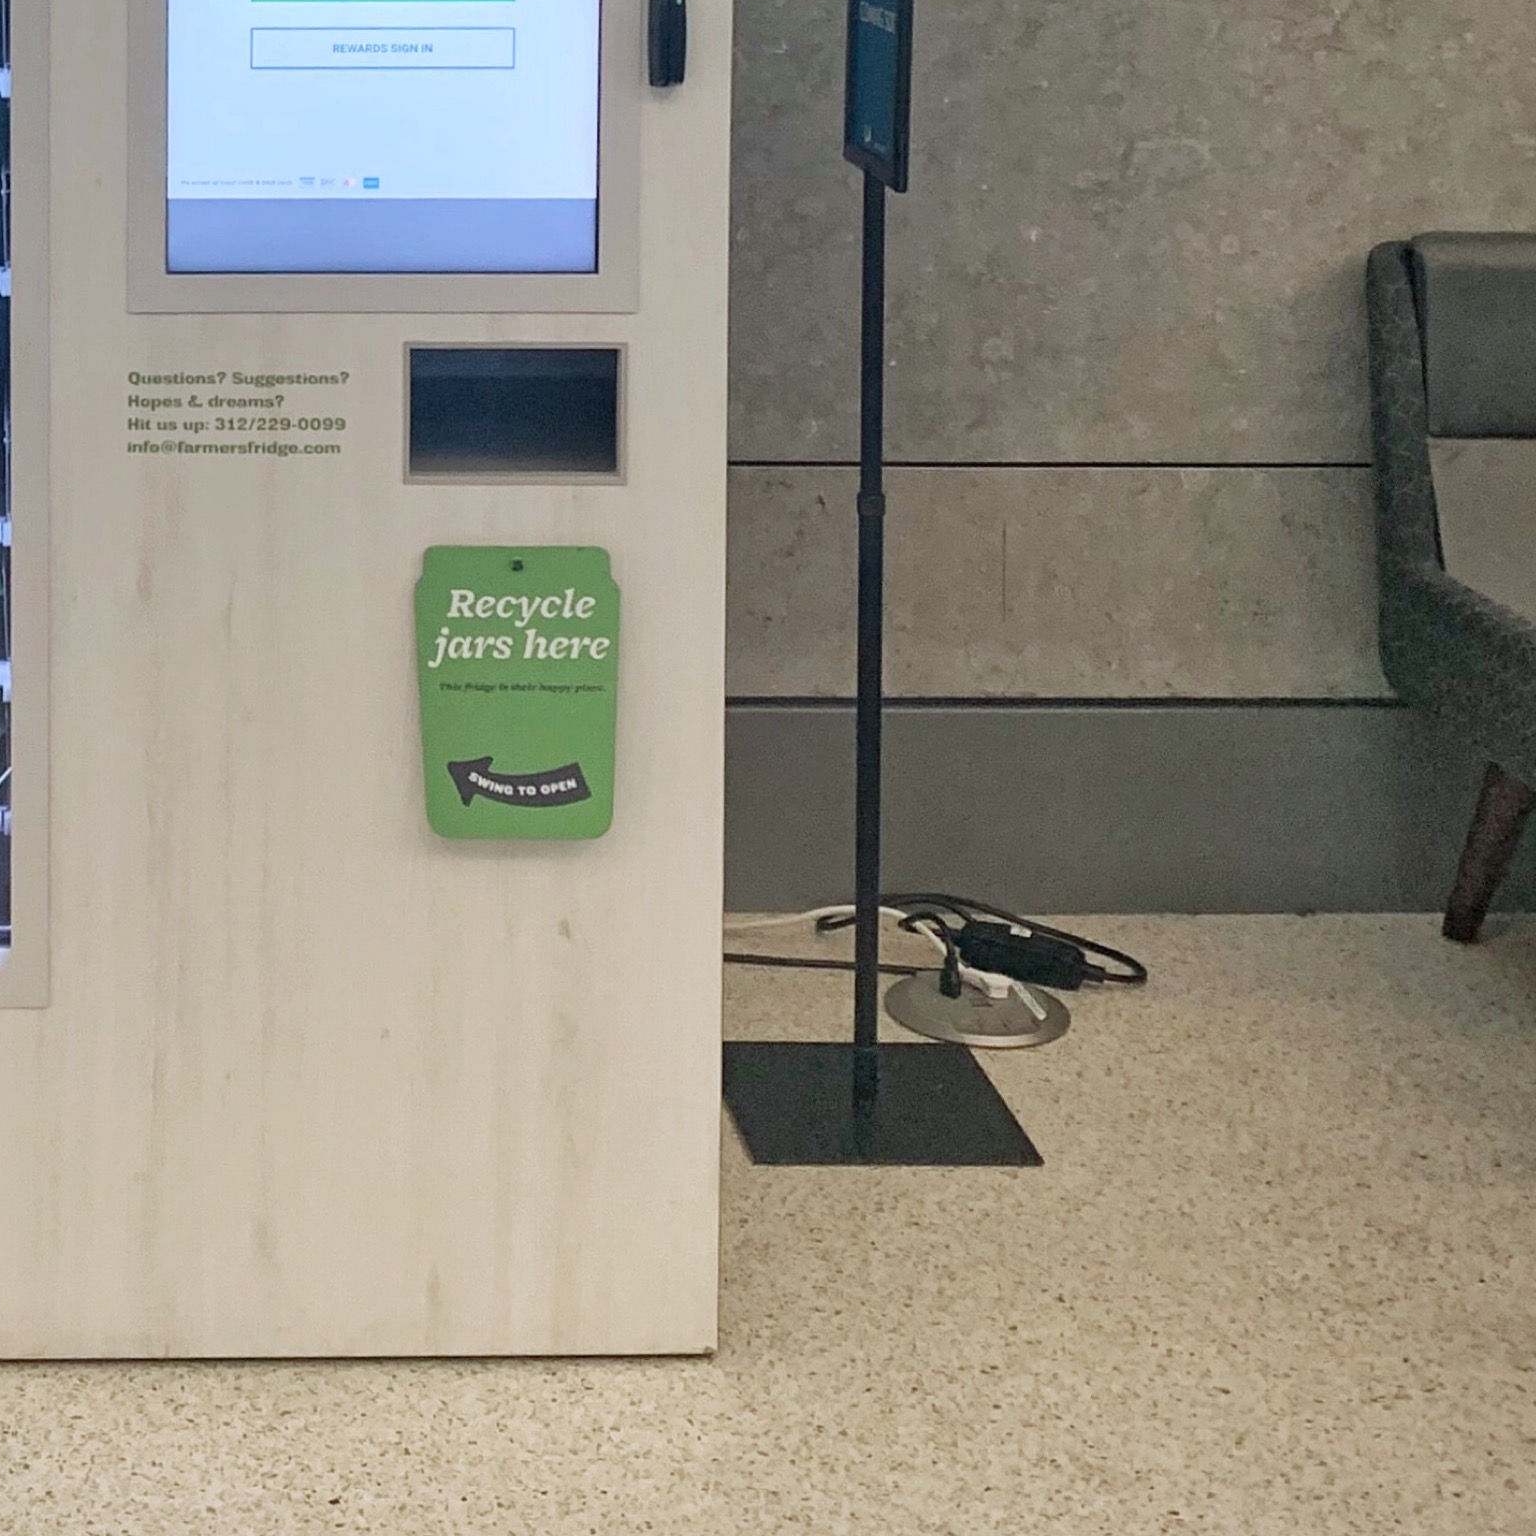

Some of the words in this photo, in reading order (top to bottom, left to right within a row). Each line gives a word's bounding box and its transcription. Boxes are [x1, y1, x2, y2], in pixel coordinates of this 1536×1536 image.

[332, 43, 388, 54] REWARDS
[390, 43, 419, 54] SIGN
[421, 43, 434, 54] IN
[127, 371, 226, 386] Questions?
[231, 371, 350, 388] Suggestions?
[127, 394, 182, 411] Hopes
[187, 394, 203, 408] &
[208, 394, 285, 408] dreams?
[127, 417, 151, 431] Hit
[156, 420, 178, 431] us
[183, 420, 210, 434] up:
[215, 417, 347, 431] 312/229-0099
[127, 440, 341, 457] info@farmersfridge.com
[447, 588, 596, 627] Recycle
[427, 626, 513, 668] jars
[523, 629, 610, 659] here
[468, 772, 513, 795] SWING
[517, 786, 537, 796] TO
[540, 778, 577, 795] OPEN
